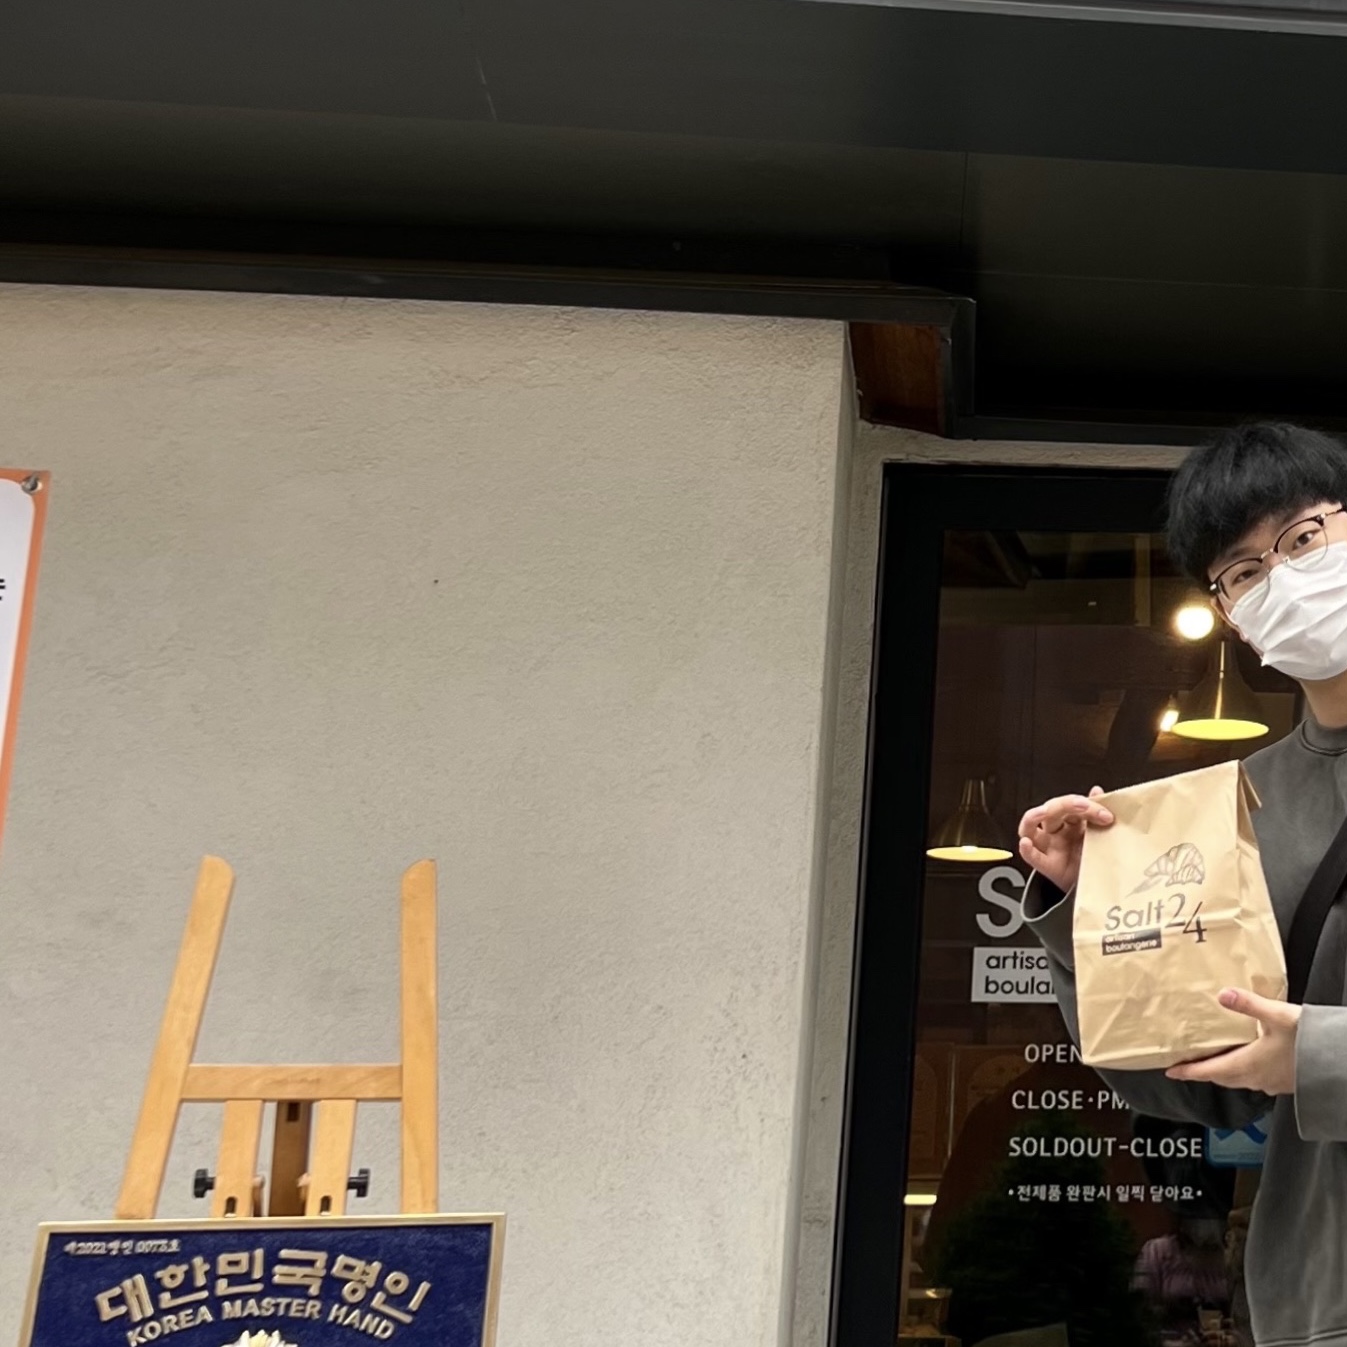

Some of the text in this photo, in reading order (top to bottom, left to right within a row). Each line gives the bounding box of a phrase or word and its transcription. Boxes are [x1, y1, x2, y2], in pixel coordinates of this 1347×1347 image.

[975, 865, 1025, 938] S
[1105, 939, 1158, 953] boulangerie
[985, 951, 1049, 969] artisa
[984, 975, 1055, 995] boula
[1008, 1137, 1202, 1157] SOLDOUT-CLOSE
[1066, 1184, 1111, 1202] 완판시
[1116, 1184, 1145, 1202] 일찍
[94, 1248, 432, 1324] 대한민국명인
[221, 1297, 322, 1321] MASTER
[327, 1303, 395, 1341] HAND
